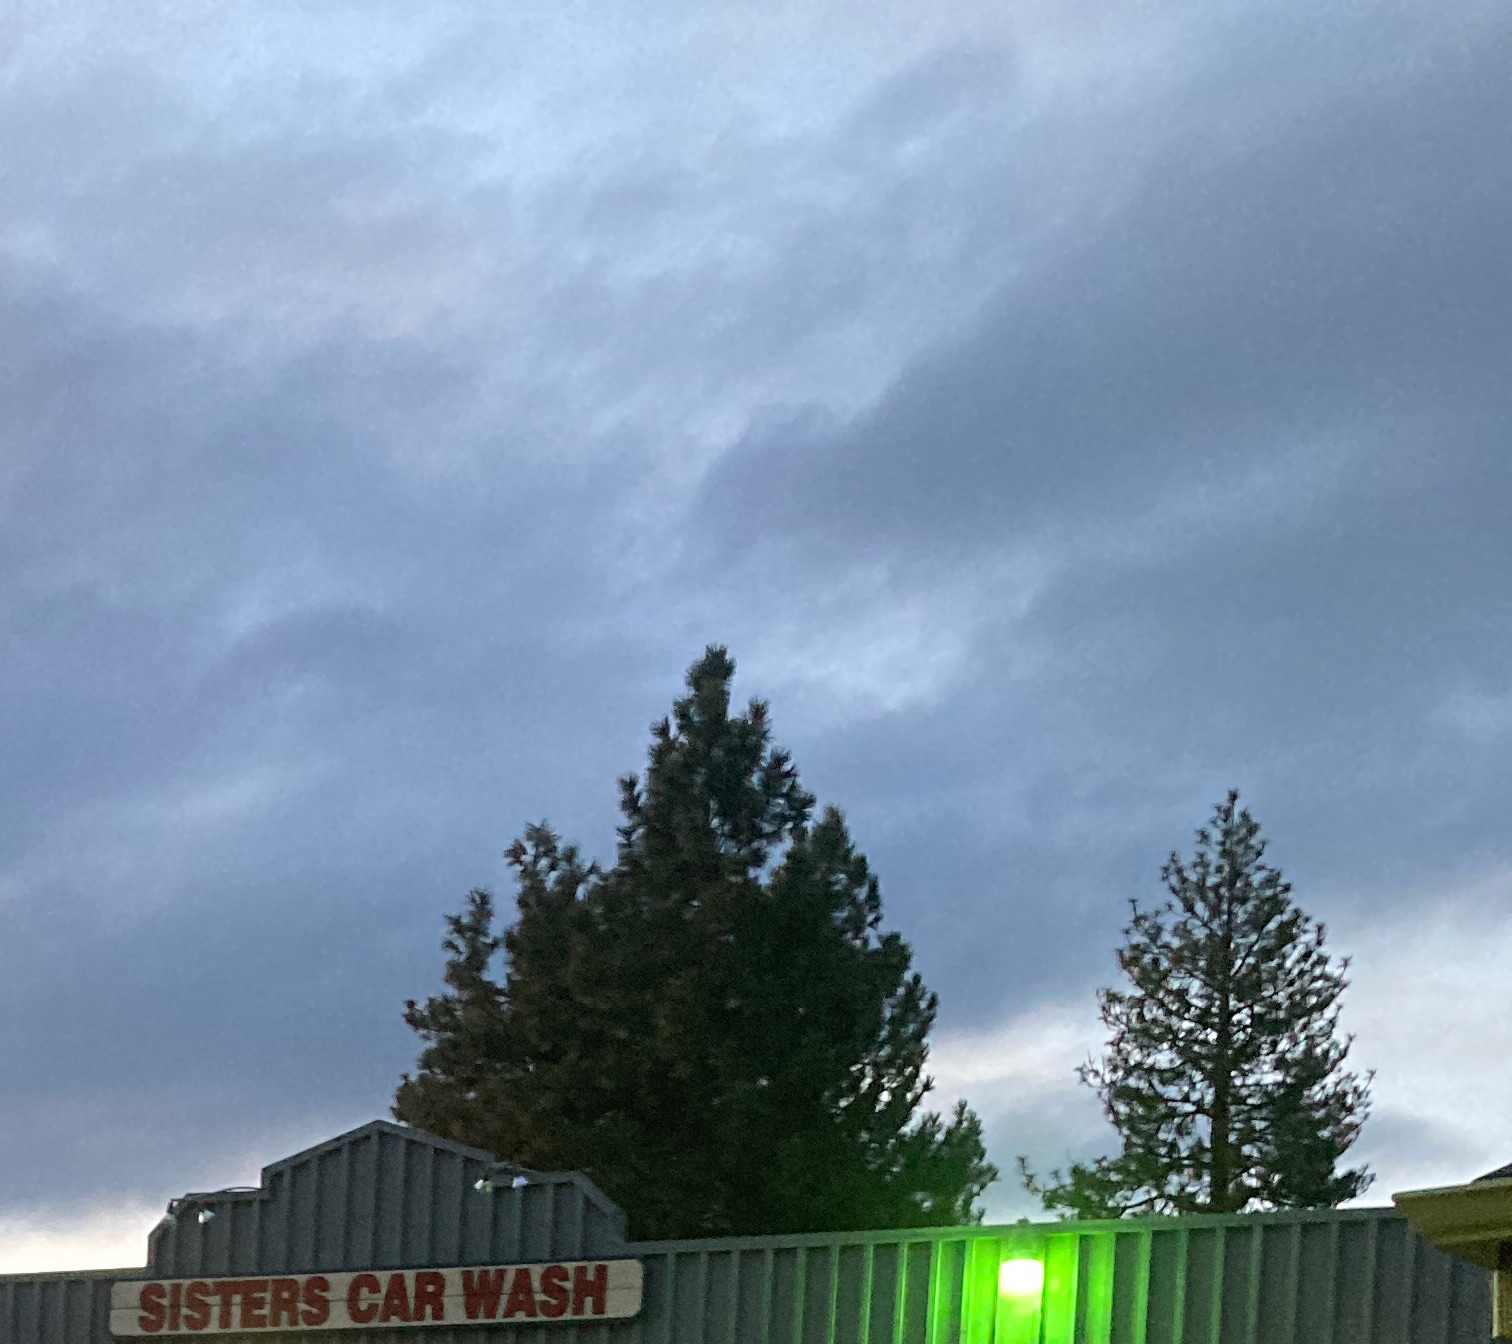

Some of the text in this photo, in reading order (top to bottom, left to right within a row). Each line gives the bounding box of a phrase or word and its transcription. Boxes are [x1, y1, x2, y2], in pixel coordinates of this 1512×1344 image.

[137, 1264, 608, 1332] SISTERS CAR WASH
